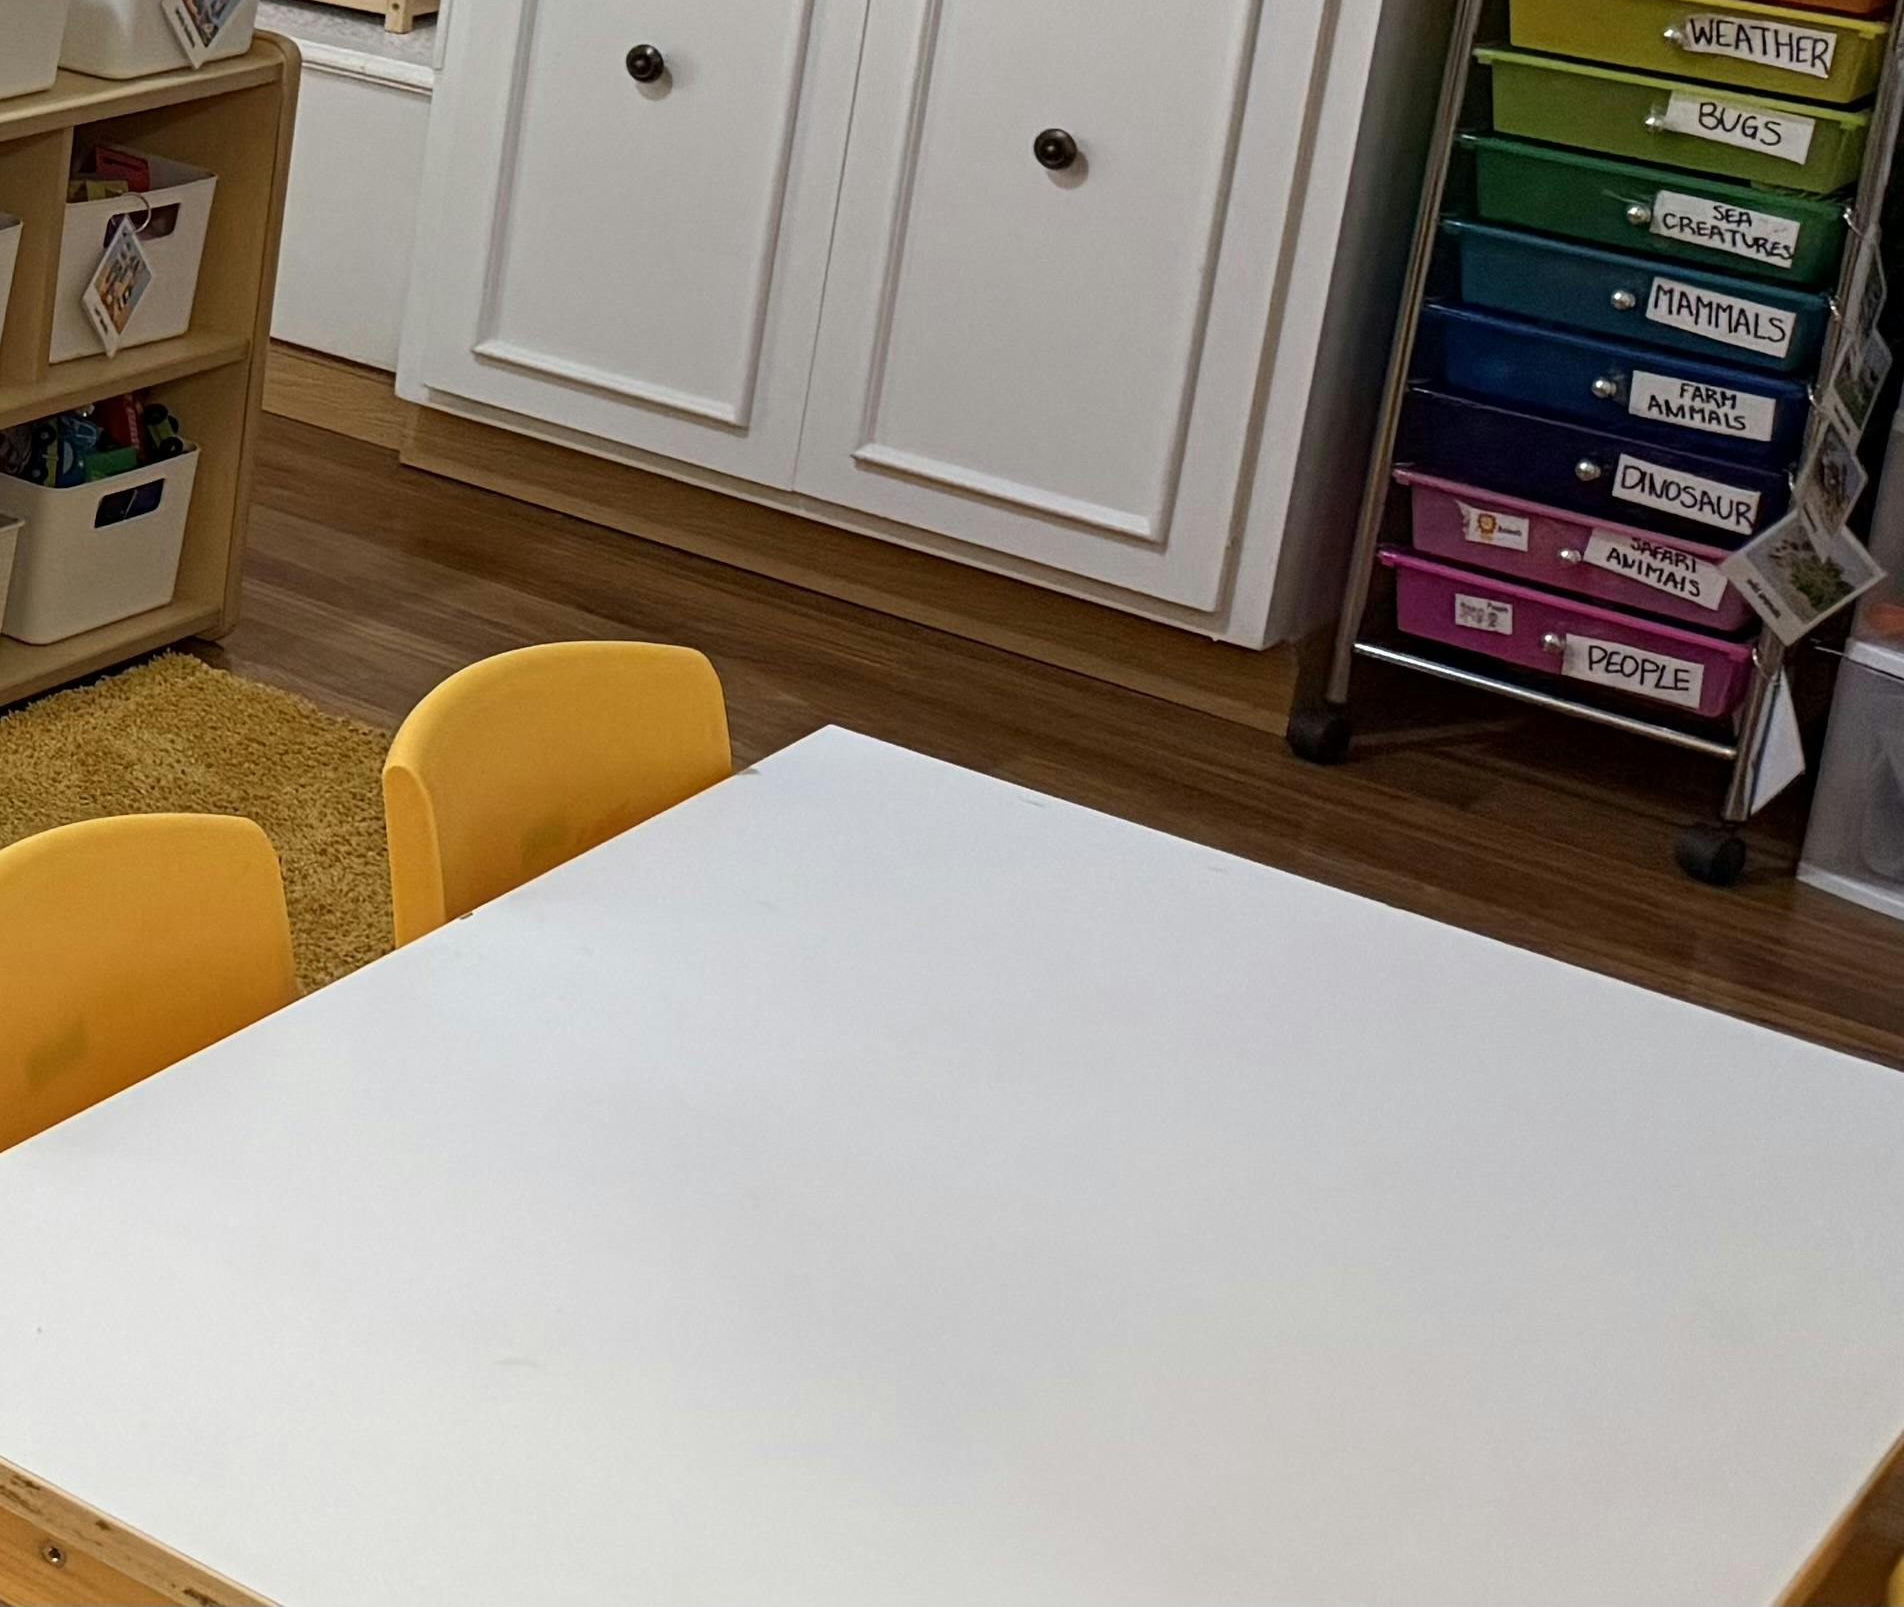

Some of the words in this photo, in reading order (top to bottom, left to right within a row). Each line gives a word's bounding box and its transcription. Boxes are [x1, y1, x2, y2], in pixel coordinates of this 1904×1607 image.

[1690, 17, 1830, 70] WEATHER
[1698, 101, 1783, 147] BUGS
[1662, 212, 1792, 261] CREATURES
[1713, 204, 1752, 228] SEA
[1653, 283, 1786, 343] MAMMALS
[1679, 382, 1738, 410] FARM
[1620, 464, 1755, 530] DINOSAUR
[1606, 547, 1702, 598] ANIMALS
[1588, 645, 1691, 691] PEOPLE
